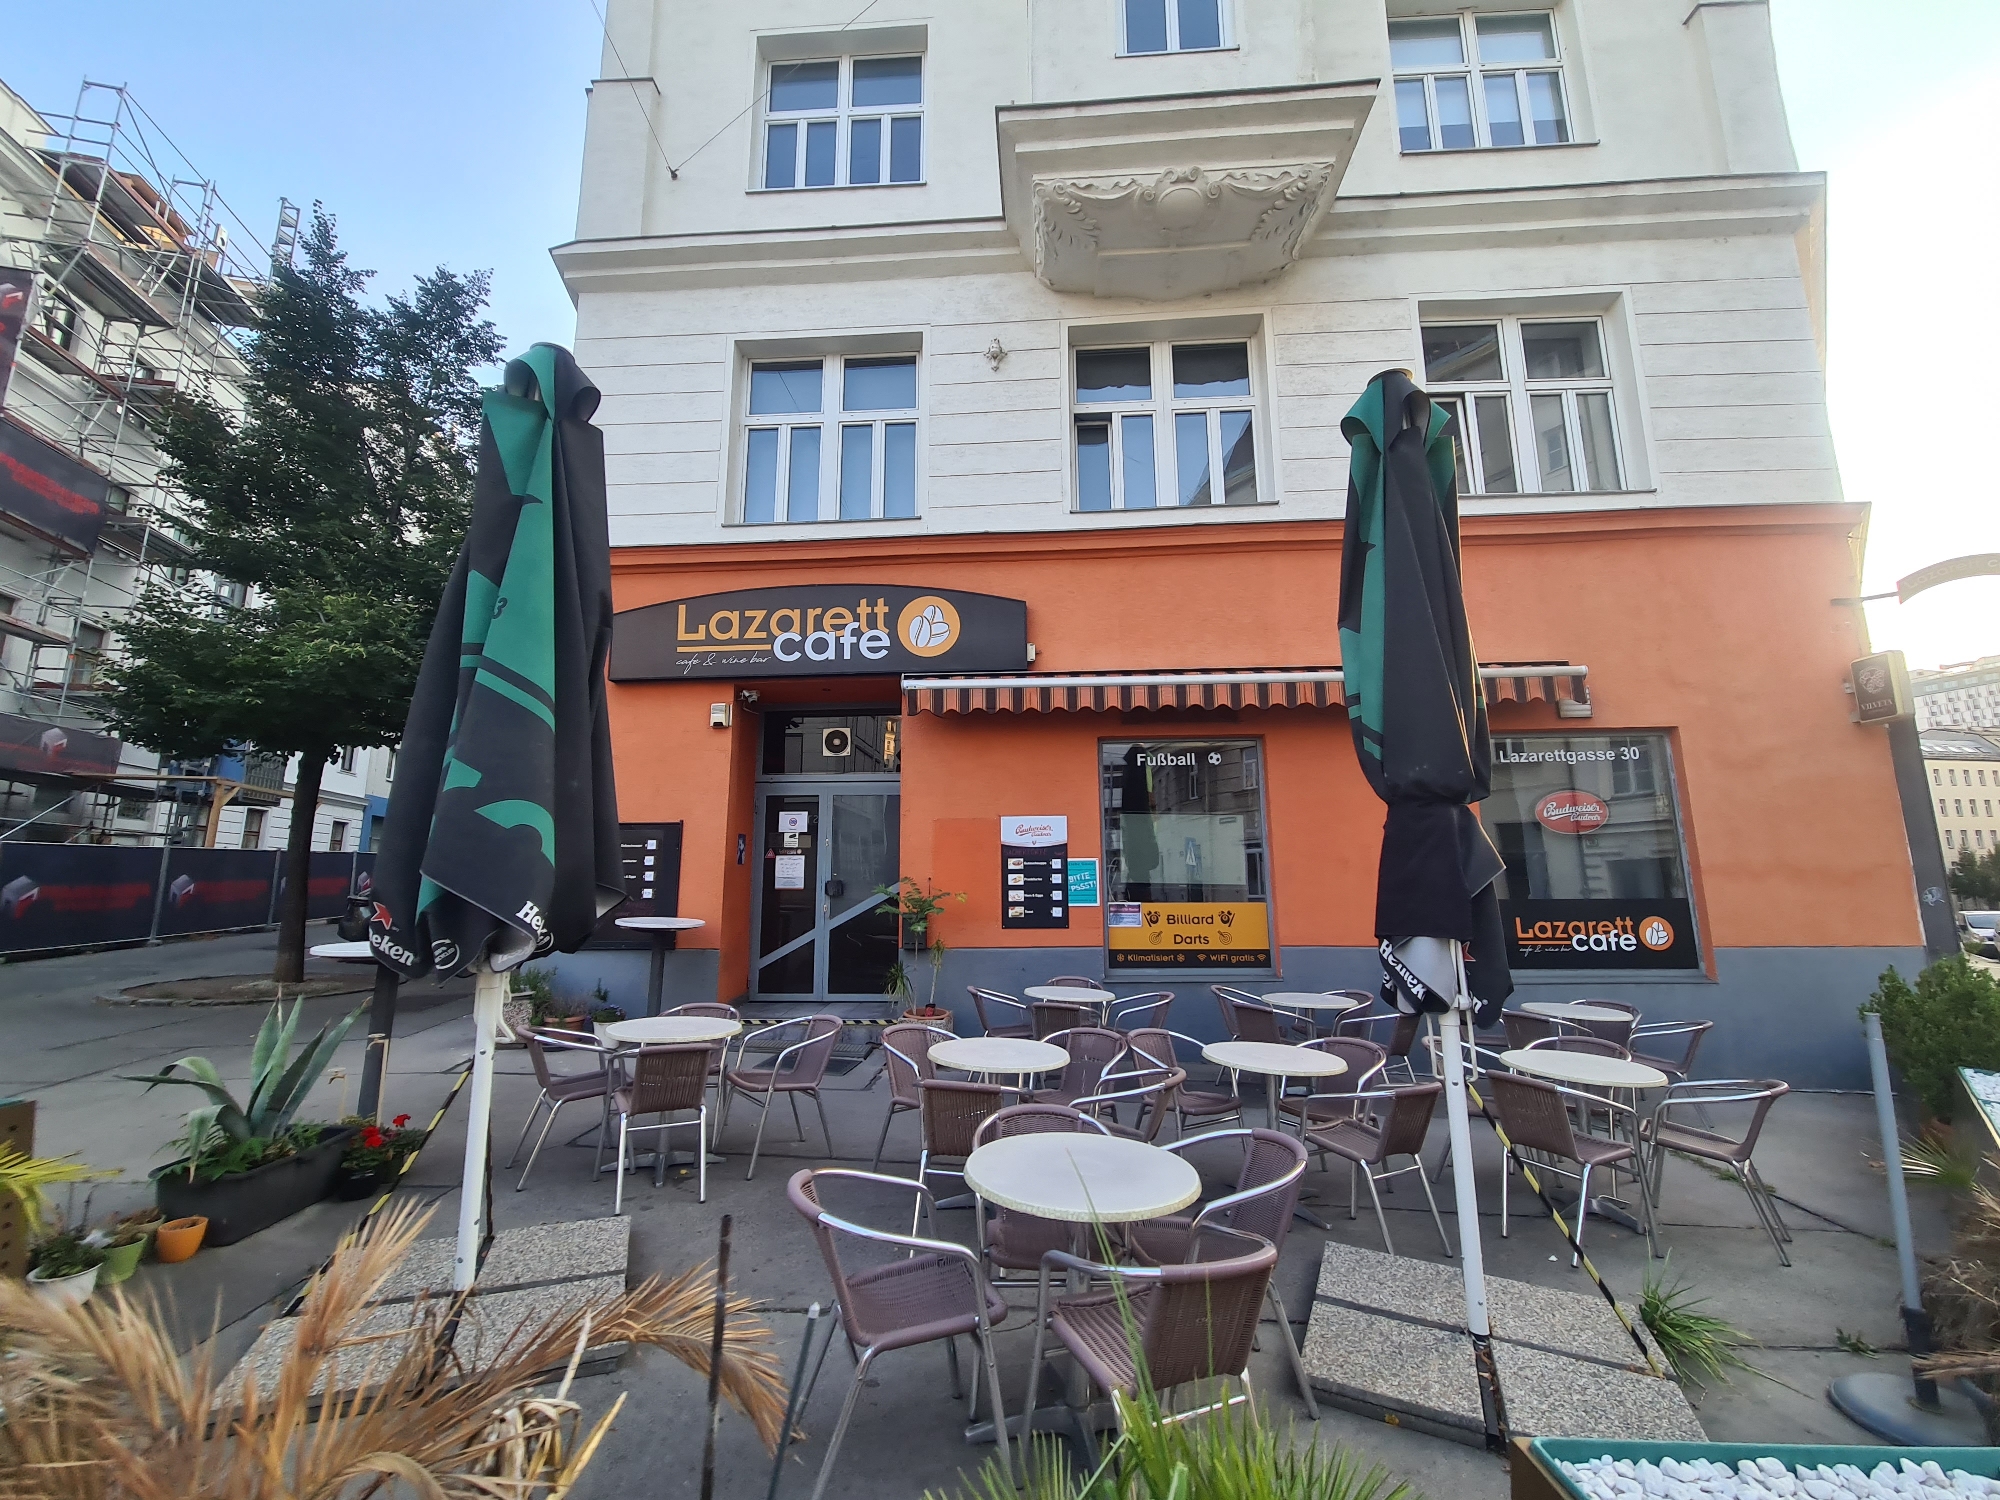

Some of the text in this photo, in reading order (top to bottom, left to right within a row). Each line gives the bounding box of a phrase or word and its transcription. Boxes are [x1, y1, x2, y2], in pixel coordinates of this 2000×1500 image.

[677, 598, 889, 641] Lazarett
[773, 622, 891, 662] cafe
[676, 651, 772, 675] cafe & wine bar
[1136, 752, 1196, 766] Fußball
[1500, 746, 1640, 764] Lazarettgasse 30
[1543, 802, 1602, 818] Budweiser
[1068, 872, 1091, 883] BITTE
[1071, 881, 1097, 892] PSSST!
[1166, 914, 1214, 926] Billiard
[1515, 916, 1635, 938] Lazarett
[1173, 933, 1210, 945] Darts
[1572, 929, 1638, 952] cafe
[1127, 953, 1255, 964] Klimatisiert WiFi gratis
